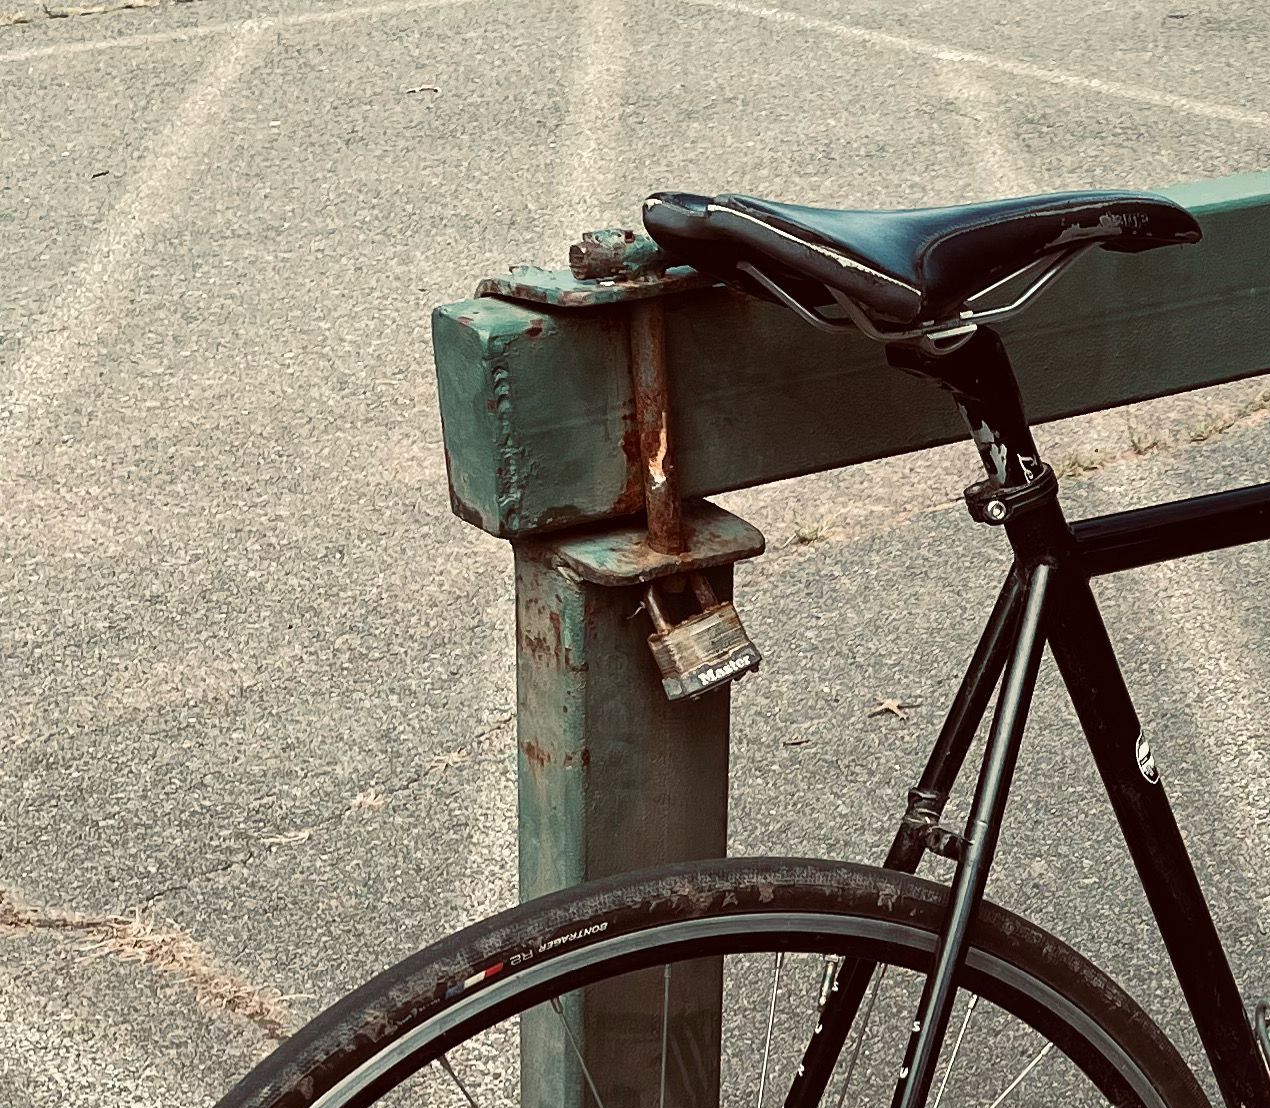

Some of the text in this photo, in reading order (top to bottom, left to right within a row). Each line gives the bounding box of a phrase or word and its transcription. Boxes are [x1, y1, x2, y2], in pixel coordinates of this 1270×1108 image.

[697, 655, 751, 686] Master
[509, 921, 609, 967] BONTRAGER R2
